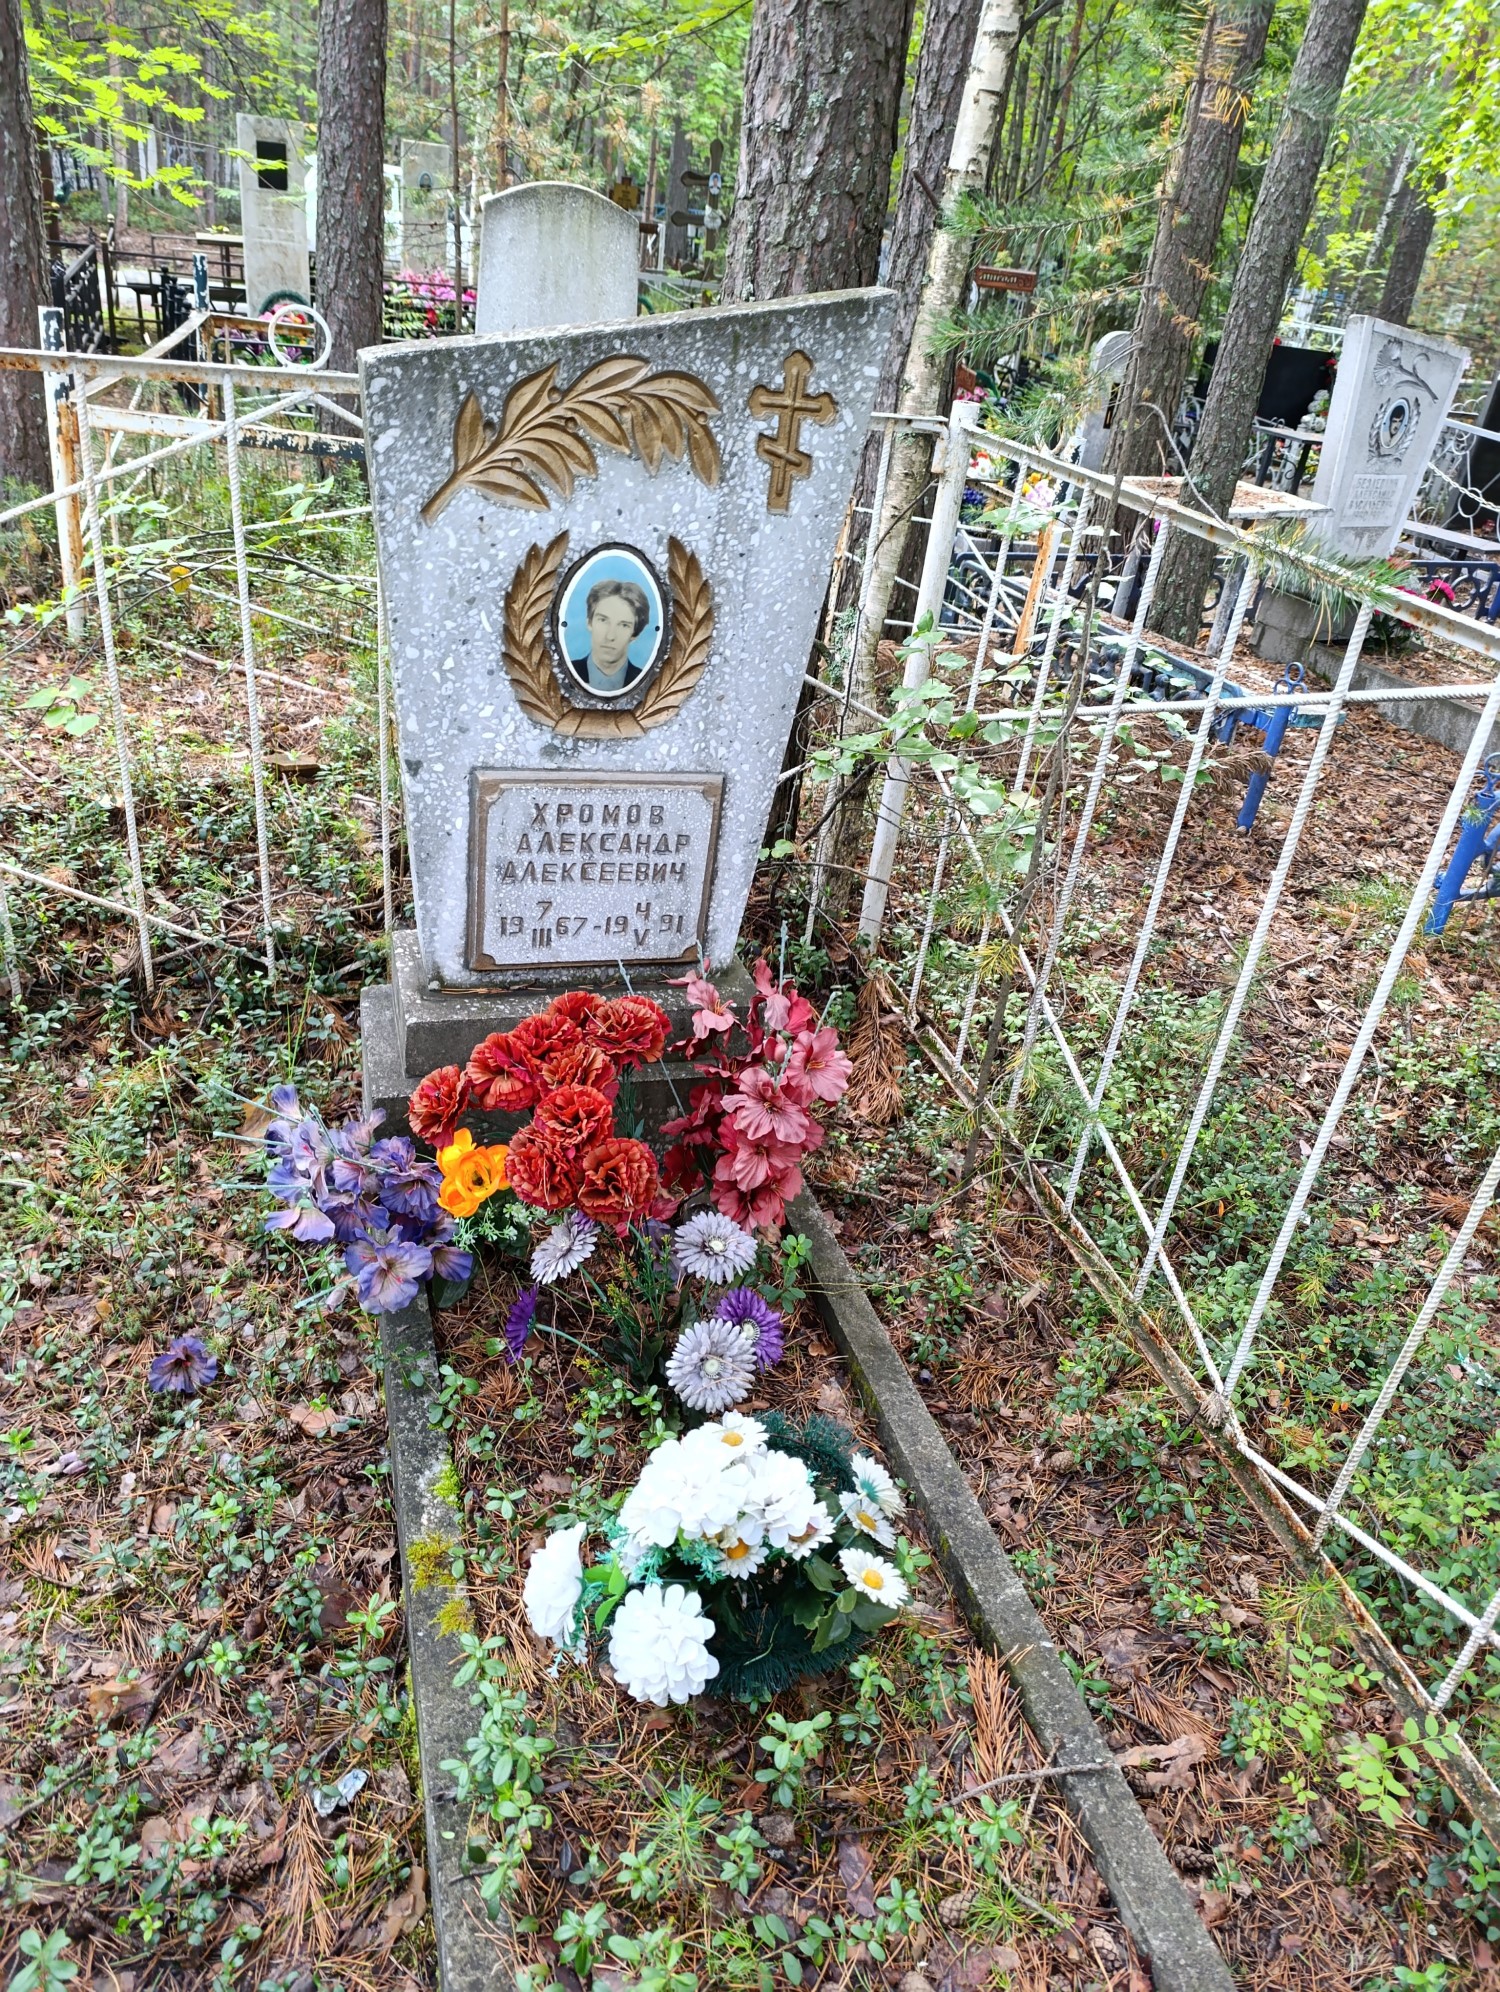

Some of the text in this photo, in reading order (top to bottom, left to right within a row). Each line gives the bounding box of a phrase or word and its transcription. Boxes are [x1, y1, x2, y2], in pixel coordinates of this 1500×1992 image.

[531, 802, 665, 826] ХРОМОВ
[516, 832, 691, 855] АЛЕКСАНДР
[501, 860, 686, 884] АЛЕКСЕЕВИЧ
